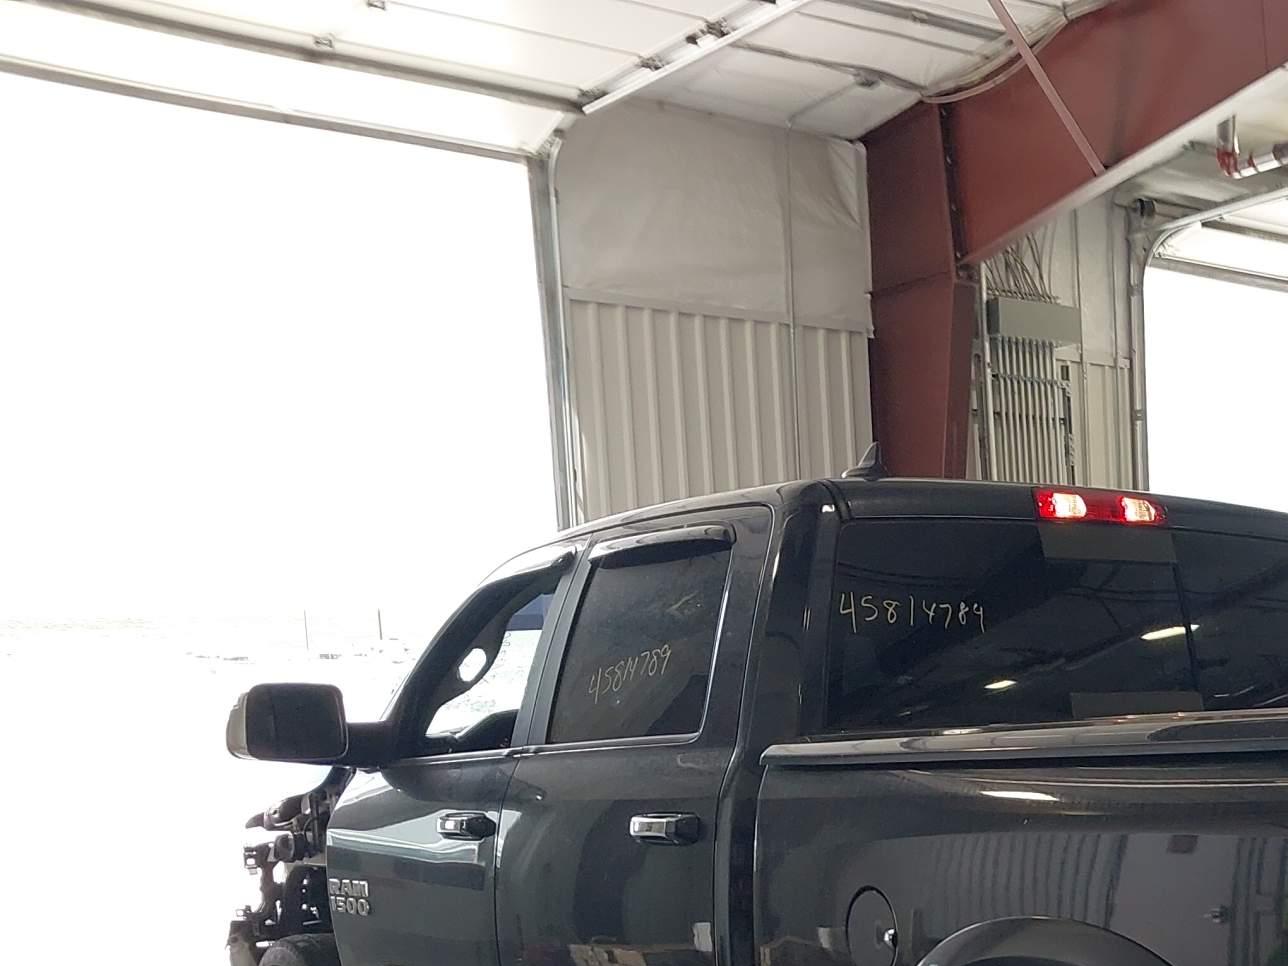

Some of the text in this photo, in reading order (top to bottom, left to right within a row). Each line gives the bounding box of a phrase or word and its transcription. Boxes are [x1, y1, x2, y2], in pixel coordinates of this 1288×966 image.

[839, 591, 986, 634] 45814789
[588, 644, 672, 705] 45814789
[328, 877, 369, 898] RAM
[330, 895, 370, 917] 1500
